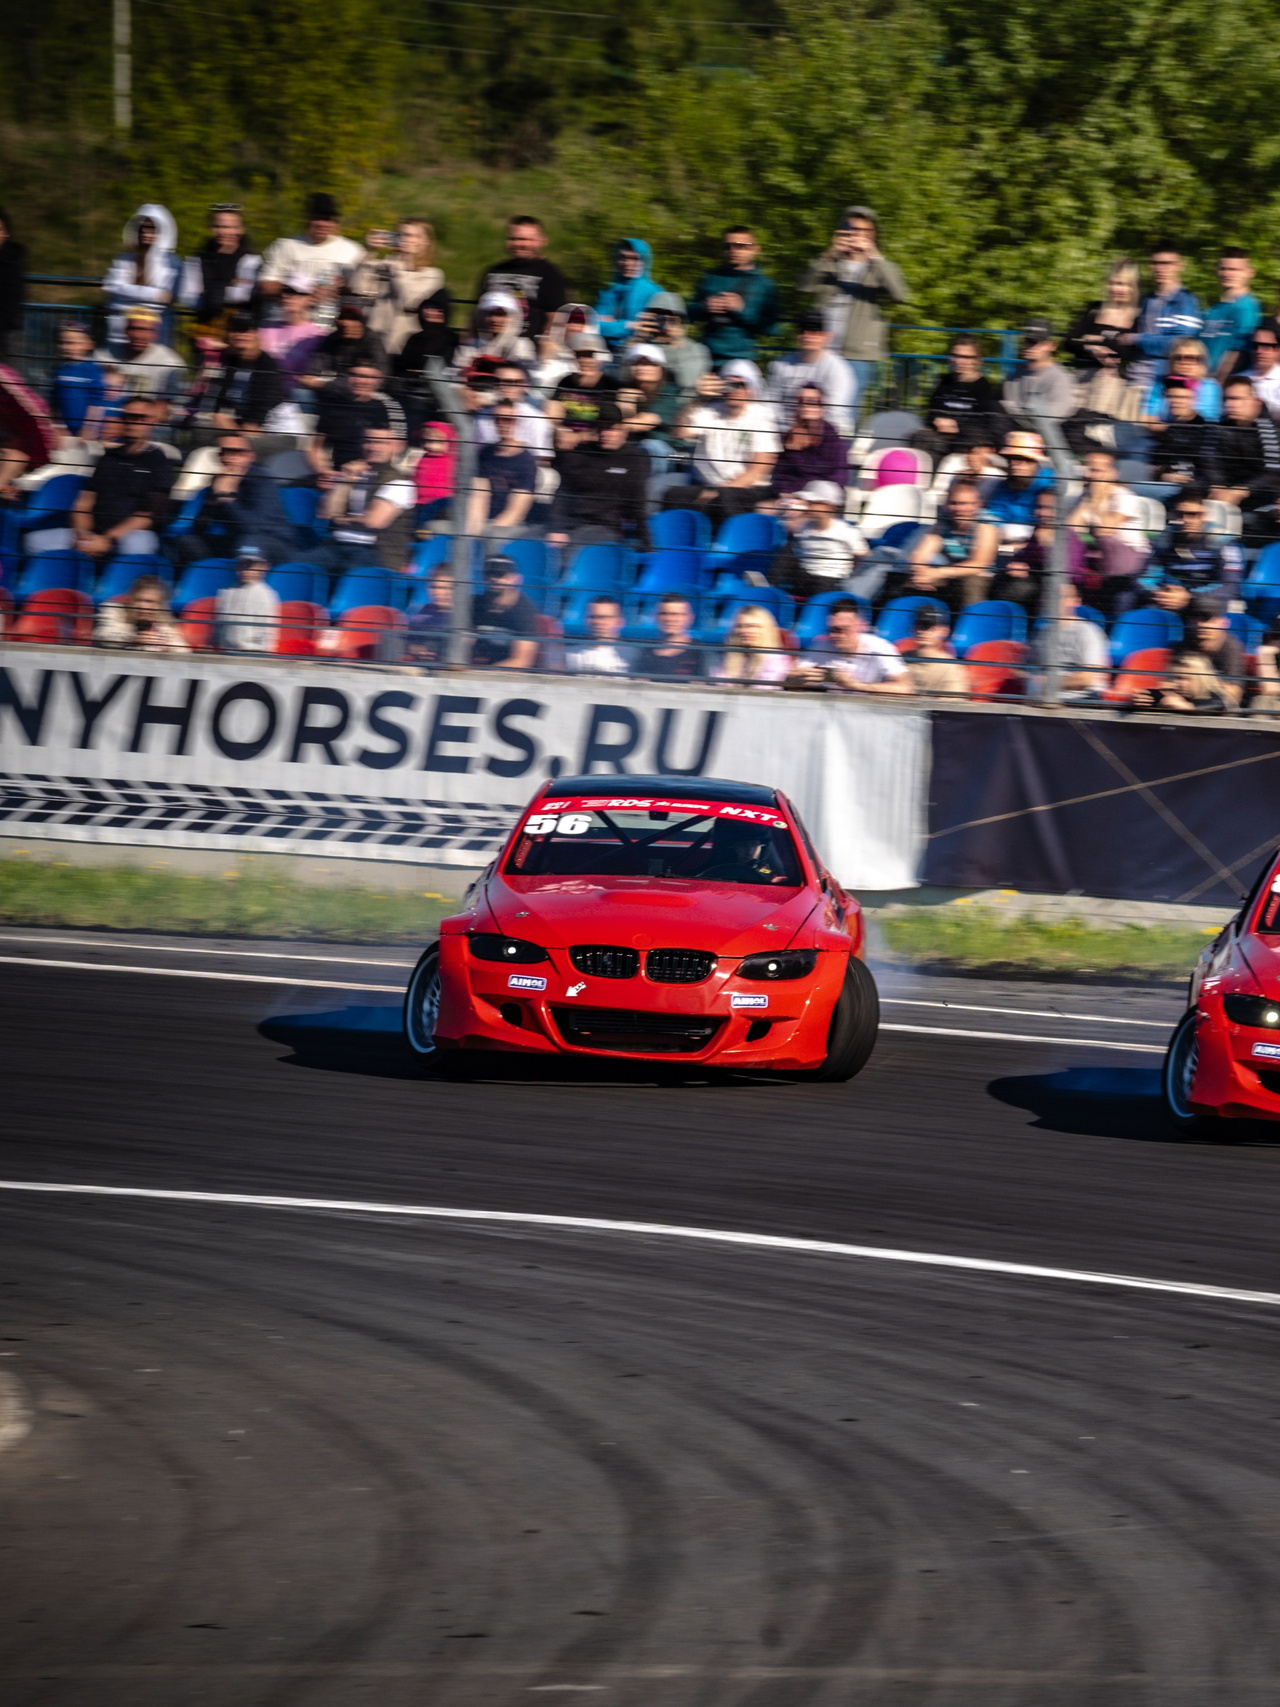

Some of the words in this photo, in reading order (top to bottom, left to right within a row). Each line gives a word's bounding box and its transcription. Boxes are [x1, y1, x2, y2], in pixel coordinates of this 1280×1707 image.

[607, 799, 656, 807] RDS
[720, 806, 779, 821] NXT
[523, 814, 592, 835] 56
